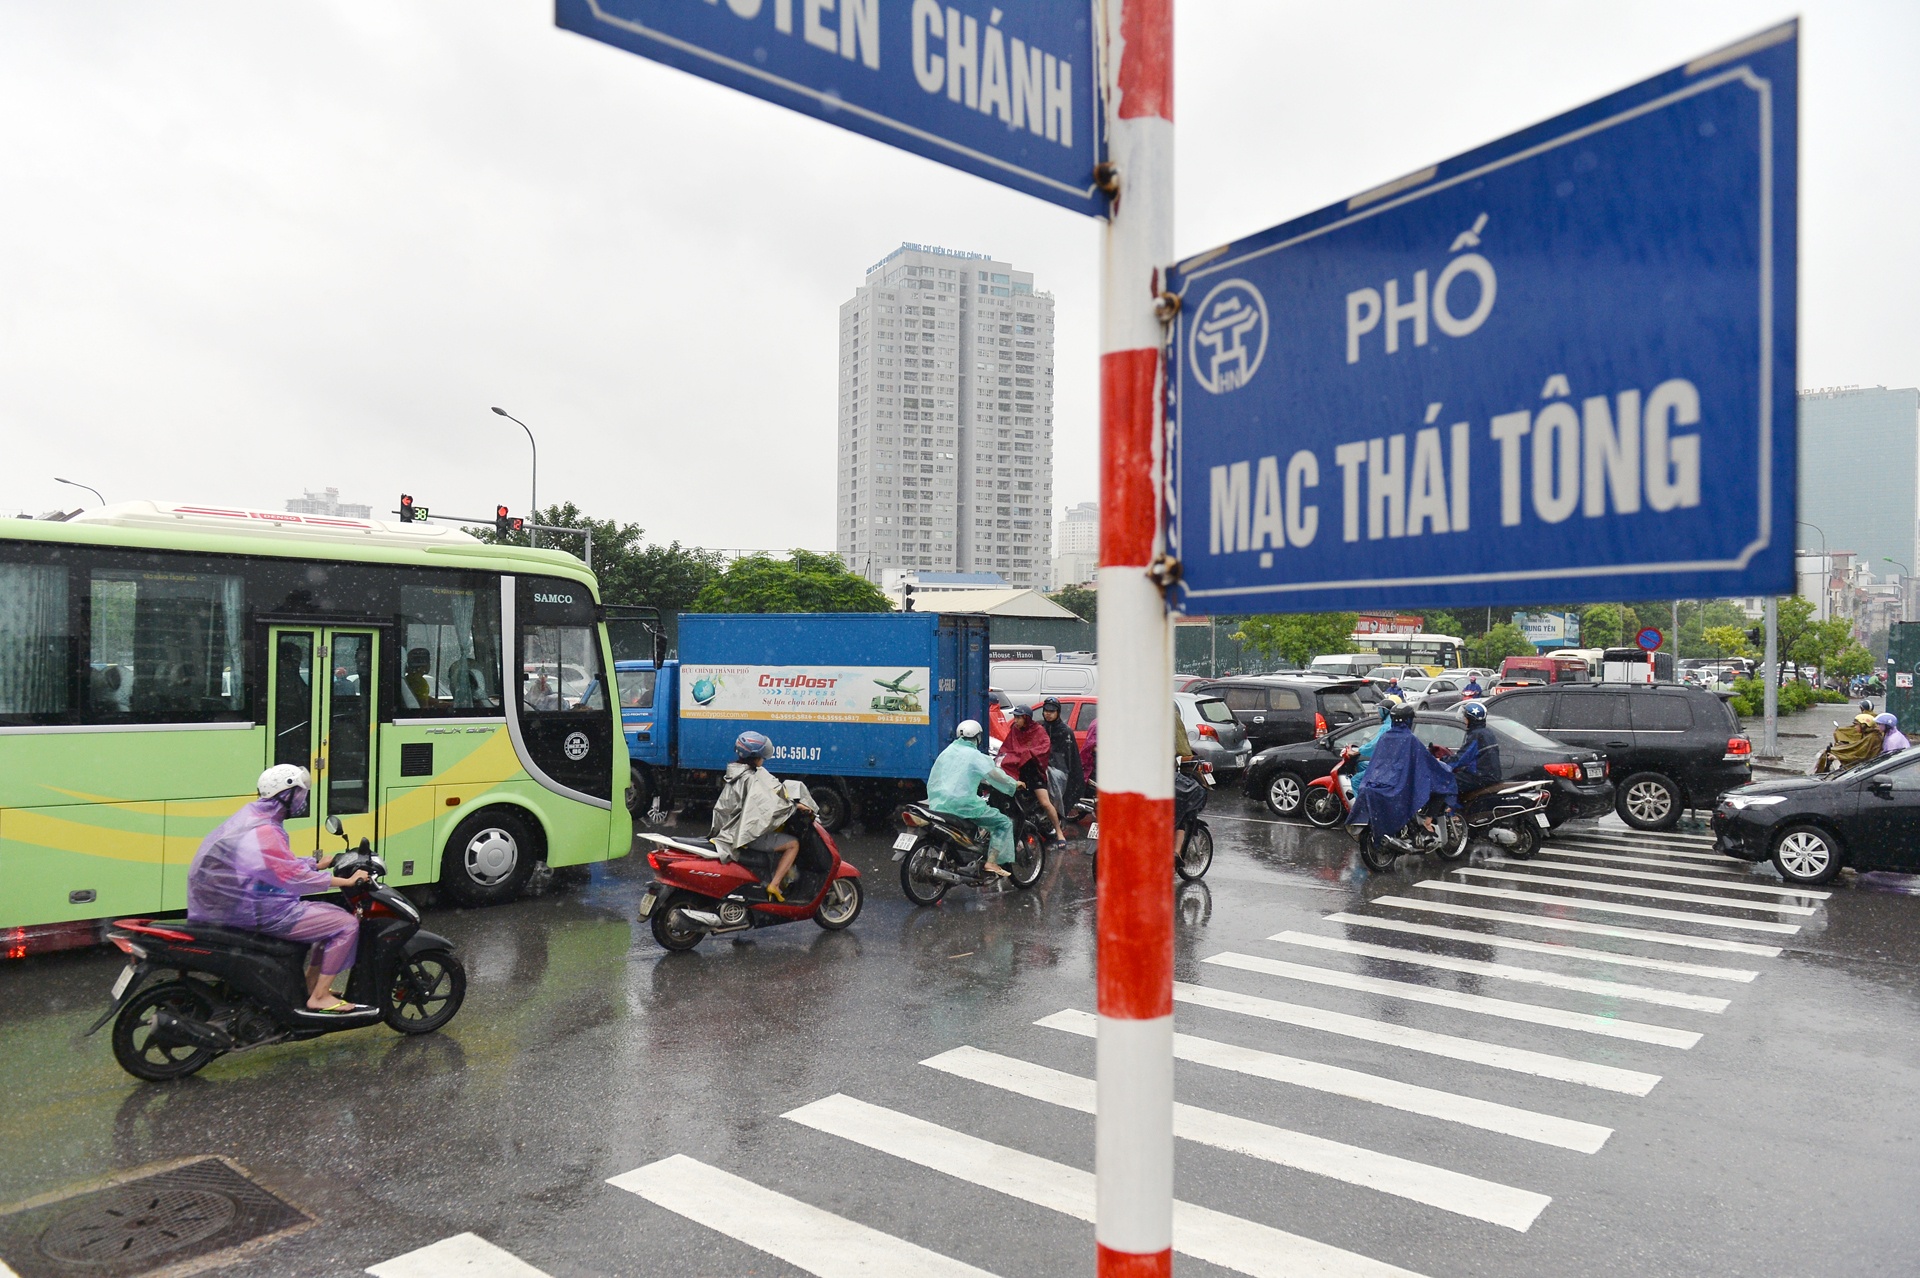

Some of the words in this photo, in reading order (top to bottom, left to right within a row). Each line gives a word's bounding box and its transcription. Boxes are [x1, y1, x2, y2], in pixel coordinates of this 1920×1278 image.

[912, 0, 1073, 148] CHÁNH
[1346, 212, 1498, 365] PHỐ
[414, 508, 426, 520] 38
[1210, 447, 1319, 570] MẠC
[1335, 402, 1471, 544] THÁI
[1490, 373, 1701, 529] TÔNG
[534, 593, 572, 603] SAMCO
